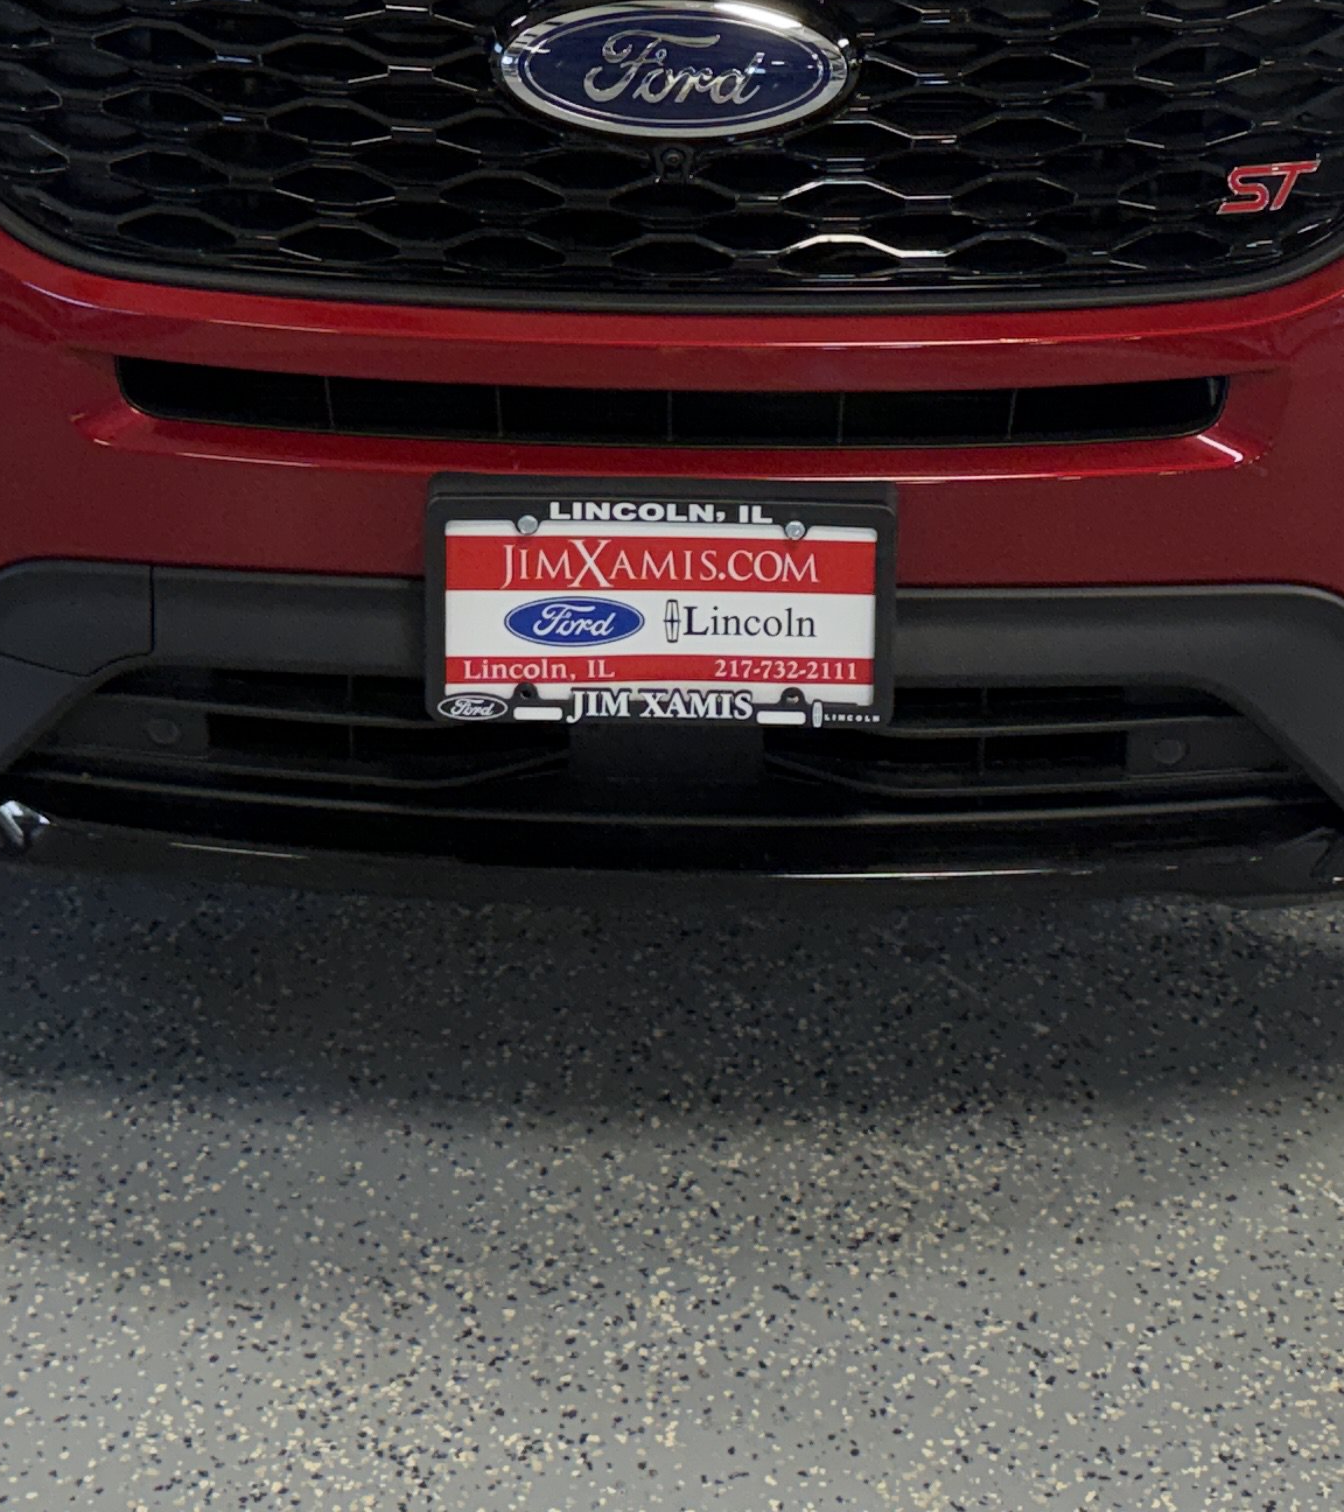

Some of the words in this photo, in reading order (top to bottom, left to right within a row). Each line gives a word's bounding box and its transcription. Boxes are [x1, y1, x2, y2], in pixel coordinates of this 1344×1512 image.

[583, 29, 765, 105] Ford
[1216, 159, 1321, 215] ST
[550, 502, 726, 523] LINCOLN,
[739, 504, 773, 524] IL
[533, 604, 616, 637] Ford
[683, 606, 817, 638] Lincoln
[464, 659, 576, 681] Lincoln,
[588, 659, 616, 680] IL
[714, 659, 857, 680] 217-732-2111
[450, 698, 495, 716] Ford
[566, 690, 632, 723] JIM
[639, 690, 754, 721] XAMIS
[824, 714, 881, 723] LINCOLN
